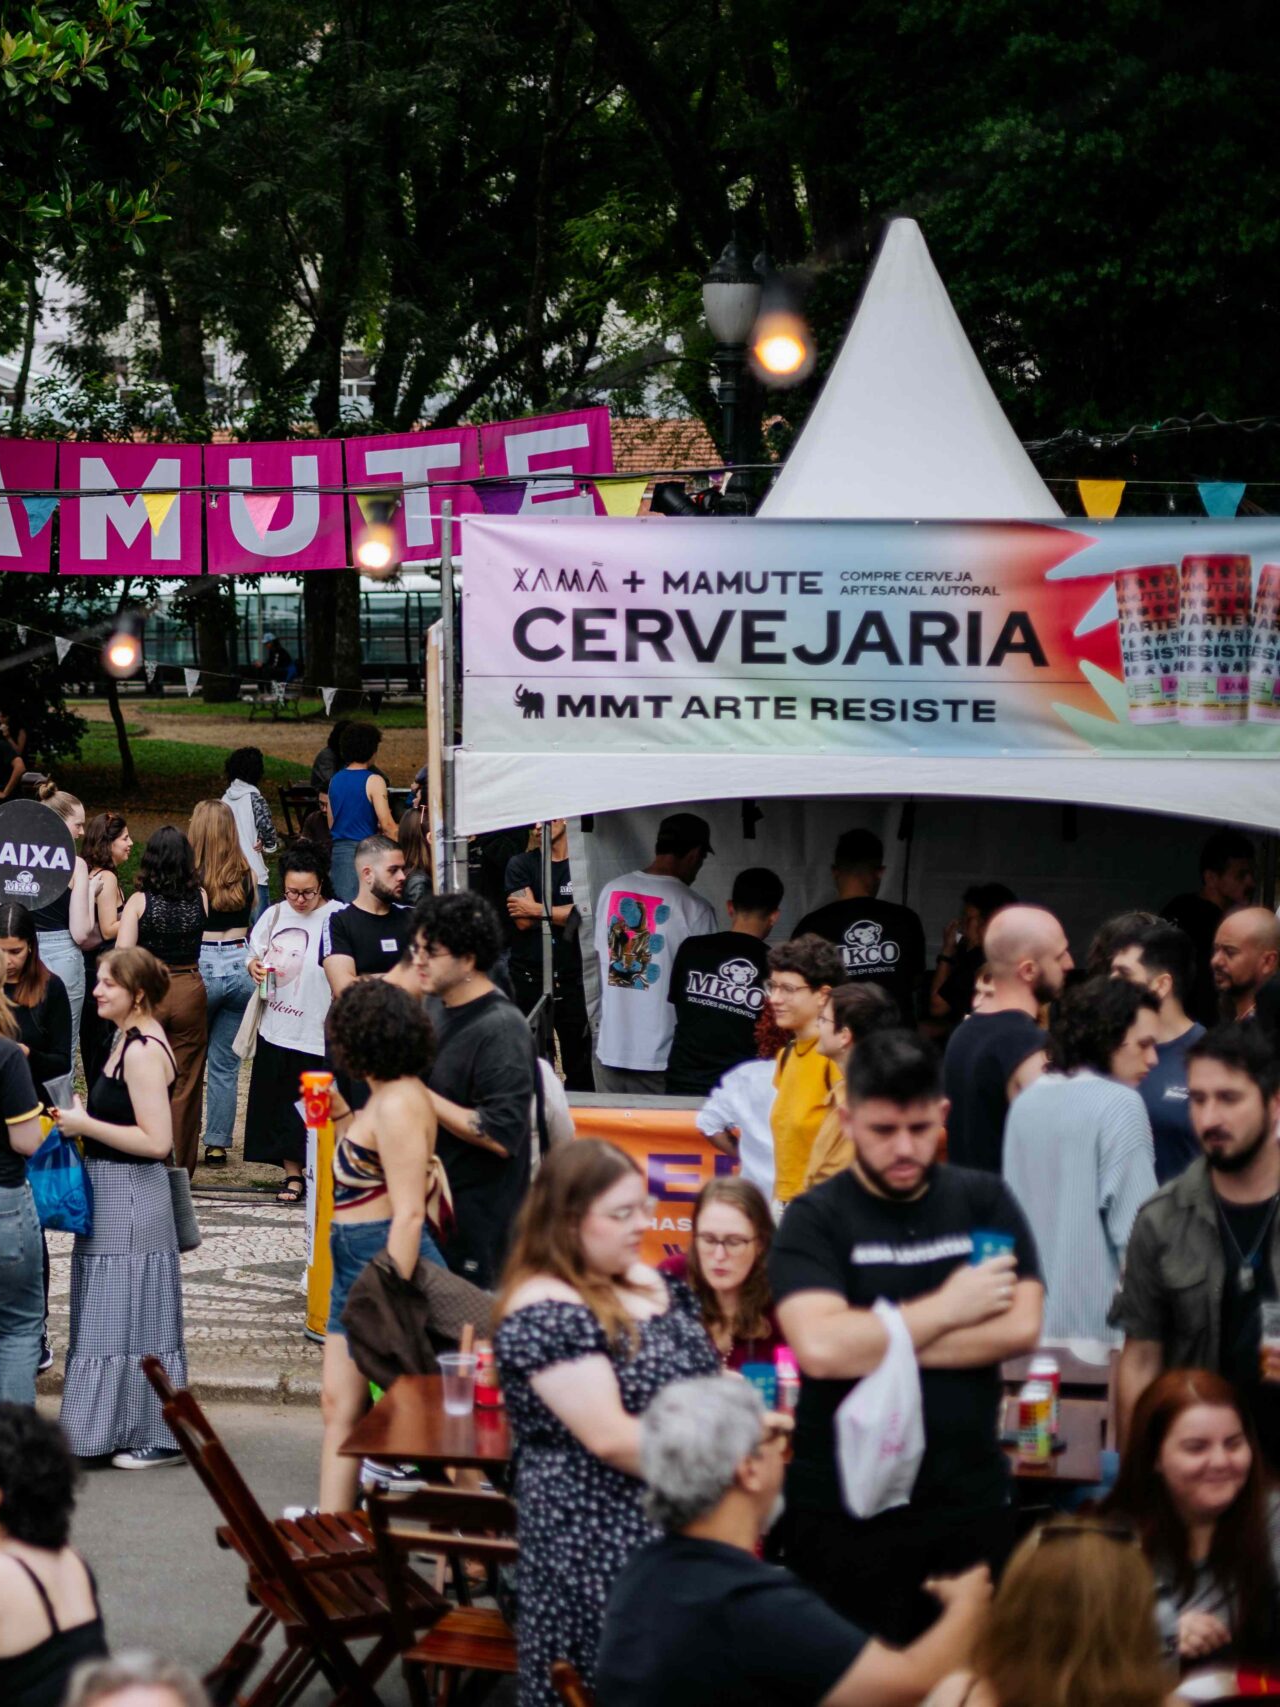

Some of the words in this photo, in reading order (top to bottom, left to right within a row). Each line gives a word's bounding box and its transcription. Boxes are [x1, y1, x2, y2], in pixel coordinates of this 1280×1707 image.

[512, 561, 608, 593] XAMÃ
[663, 570, 823, 595] MAMUTE
[840, 571, 902, 582] COMPRE
[905, 571, 973, 583] CERVEJA
[840, 585, 928, 596] ARTESANAL
[930, 585, 1001, 597] AUTORAL
[512, 606, 1050, 667] CERVEJARIA
[557, 694, 673, 719] MMT
[681, 695, 797, 720] ARTE
[810, 697, 996, 723] RESISTE
[837, 941, 900, 967] KCO
[686, 971, 766, 1010] MKCO
[728, 1006, 757, 1019] EVENTOS
